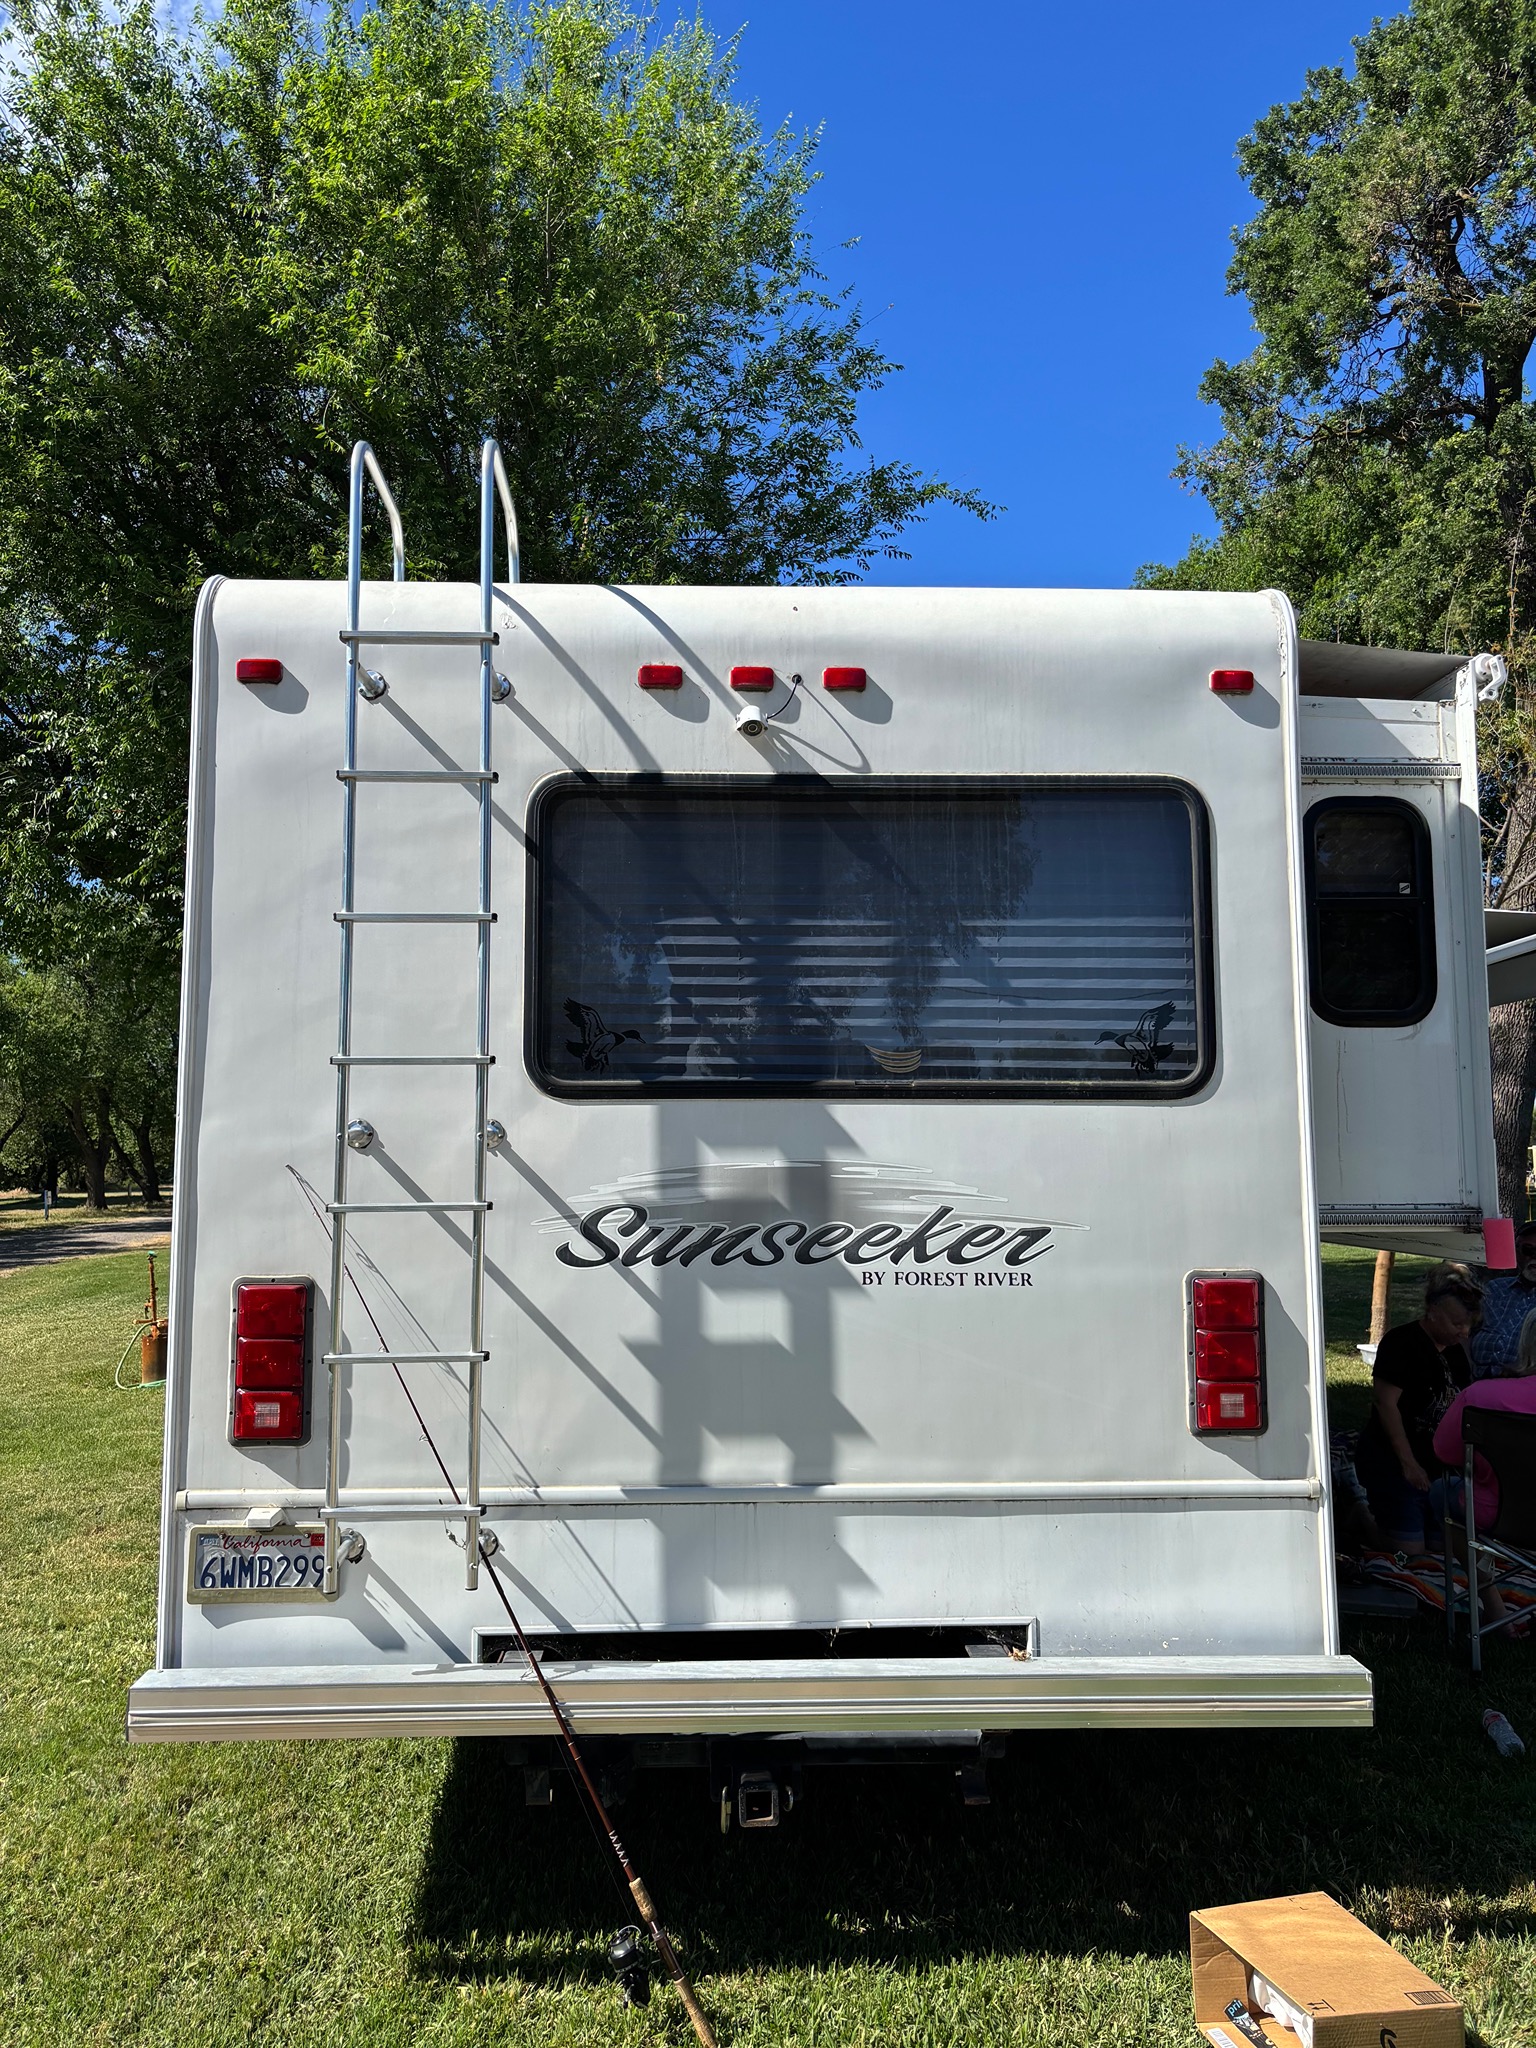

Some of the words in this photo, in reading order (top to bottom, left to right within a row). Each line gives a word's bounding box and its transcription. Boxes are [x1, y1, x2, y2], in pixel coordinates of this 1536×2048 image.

[555, 1204, 1056, 1268] Sunseeker
[861, 1271, 886, 1286] BY
[894, 1271, 968, 1287] FOREST
[974, 1272, 1034, 1287] RIVER
[223, 1534, 311, 1554] California
[200, 1554, 325, 1589] 6WMB299
